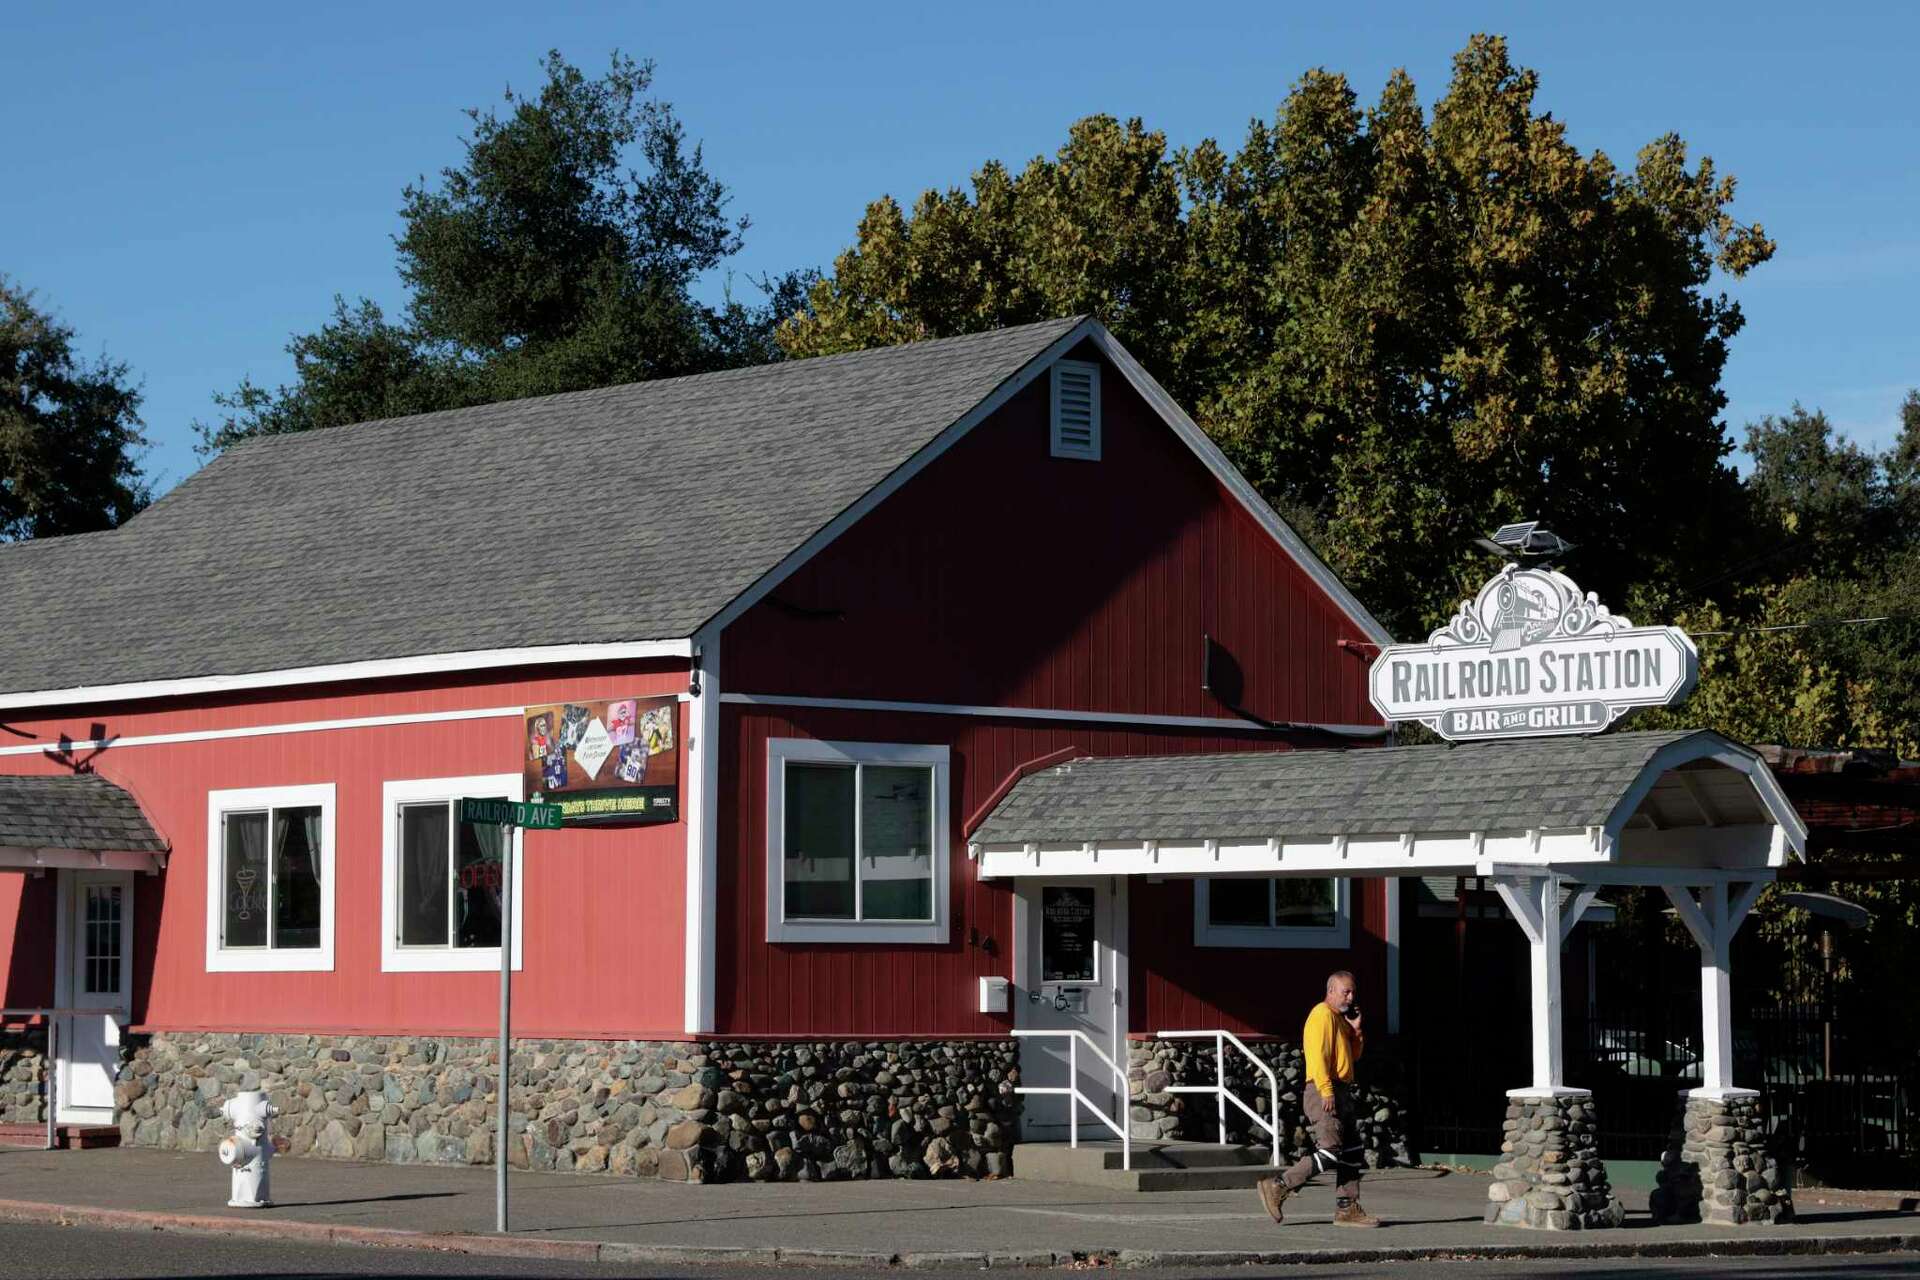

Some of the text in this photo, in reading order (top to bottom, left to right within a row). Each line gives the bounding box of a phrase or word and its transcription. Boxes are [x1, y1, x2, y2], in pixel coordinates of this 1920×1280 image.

[1392, 648, 1662, 703] RAILROAD STATION
[1453, 704, 1598, 732] BAR AND GRILL
[467, 800, 526, 824] RAILROAD
[530, 806, 556, 826] AVE
